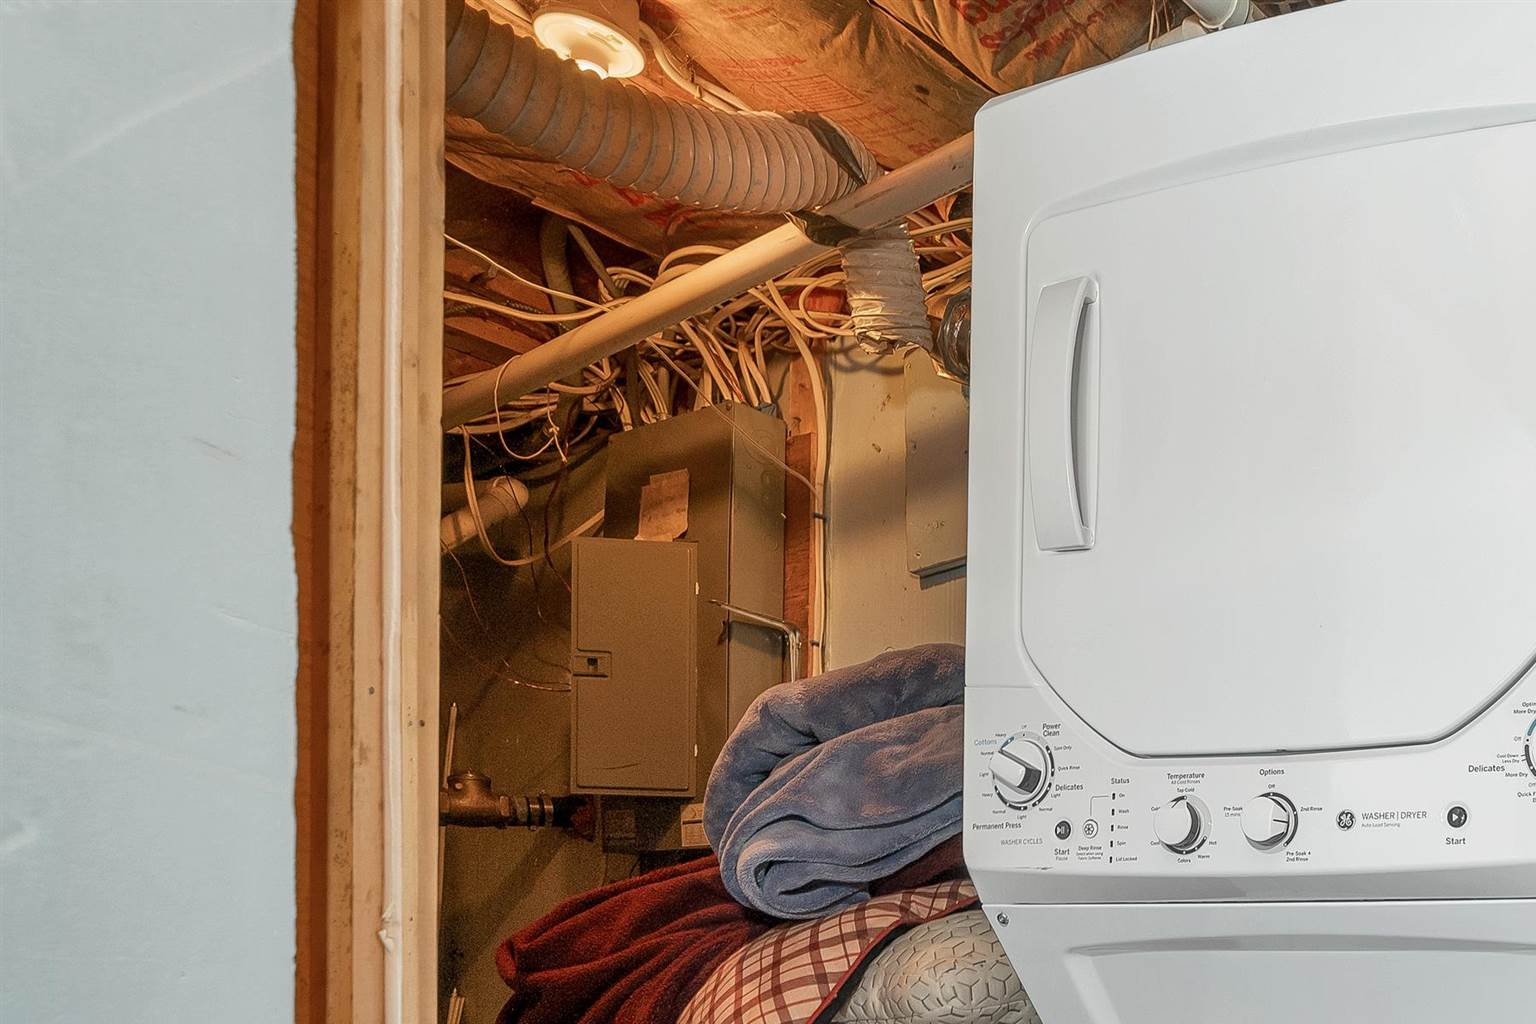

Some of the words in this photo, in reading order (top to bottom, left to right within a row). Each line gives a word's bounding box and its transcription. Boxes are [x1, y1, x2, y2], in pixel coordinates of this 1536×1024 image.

[1259, 768, 1285, 776] Options
[1468, 765, 1505, 773] Delicates
[1055, 784, 1084, 792] Delicates
[1361, 812, 1395, 820] WASHER
[1400, 811, 1428, 819] DRYER
[972, 822, 1004, 830] Permanent
[1005, 821, 1022, 829] Press
[1445, 837, 1466, 845] Start
